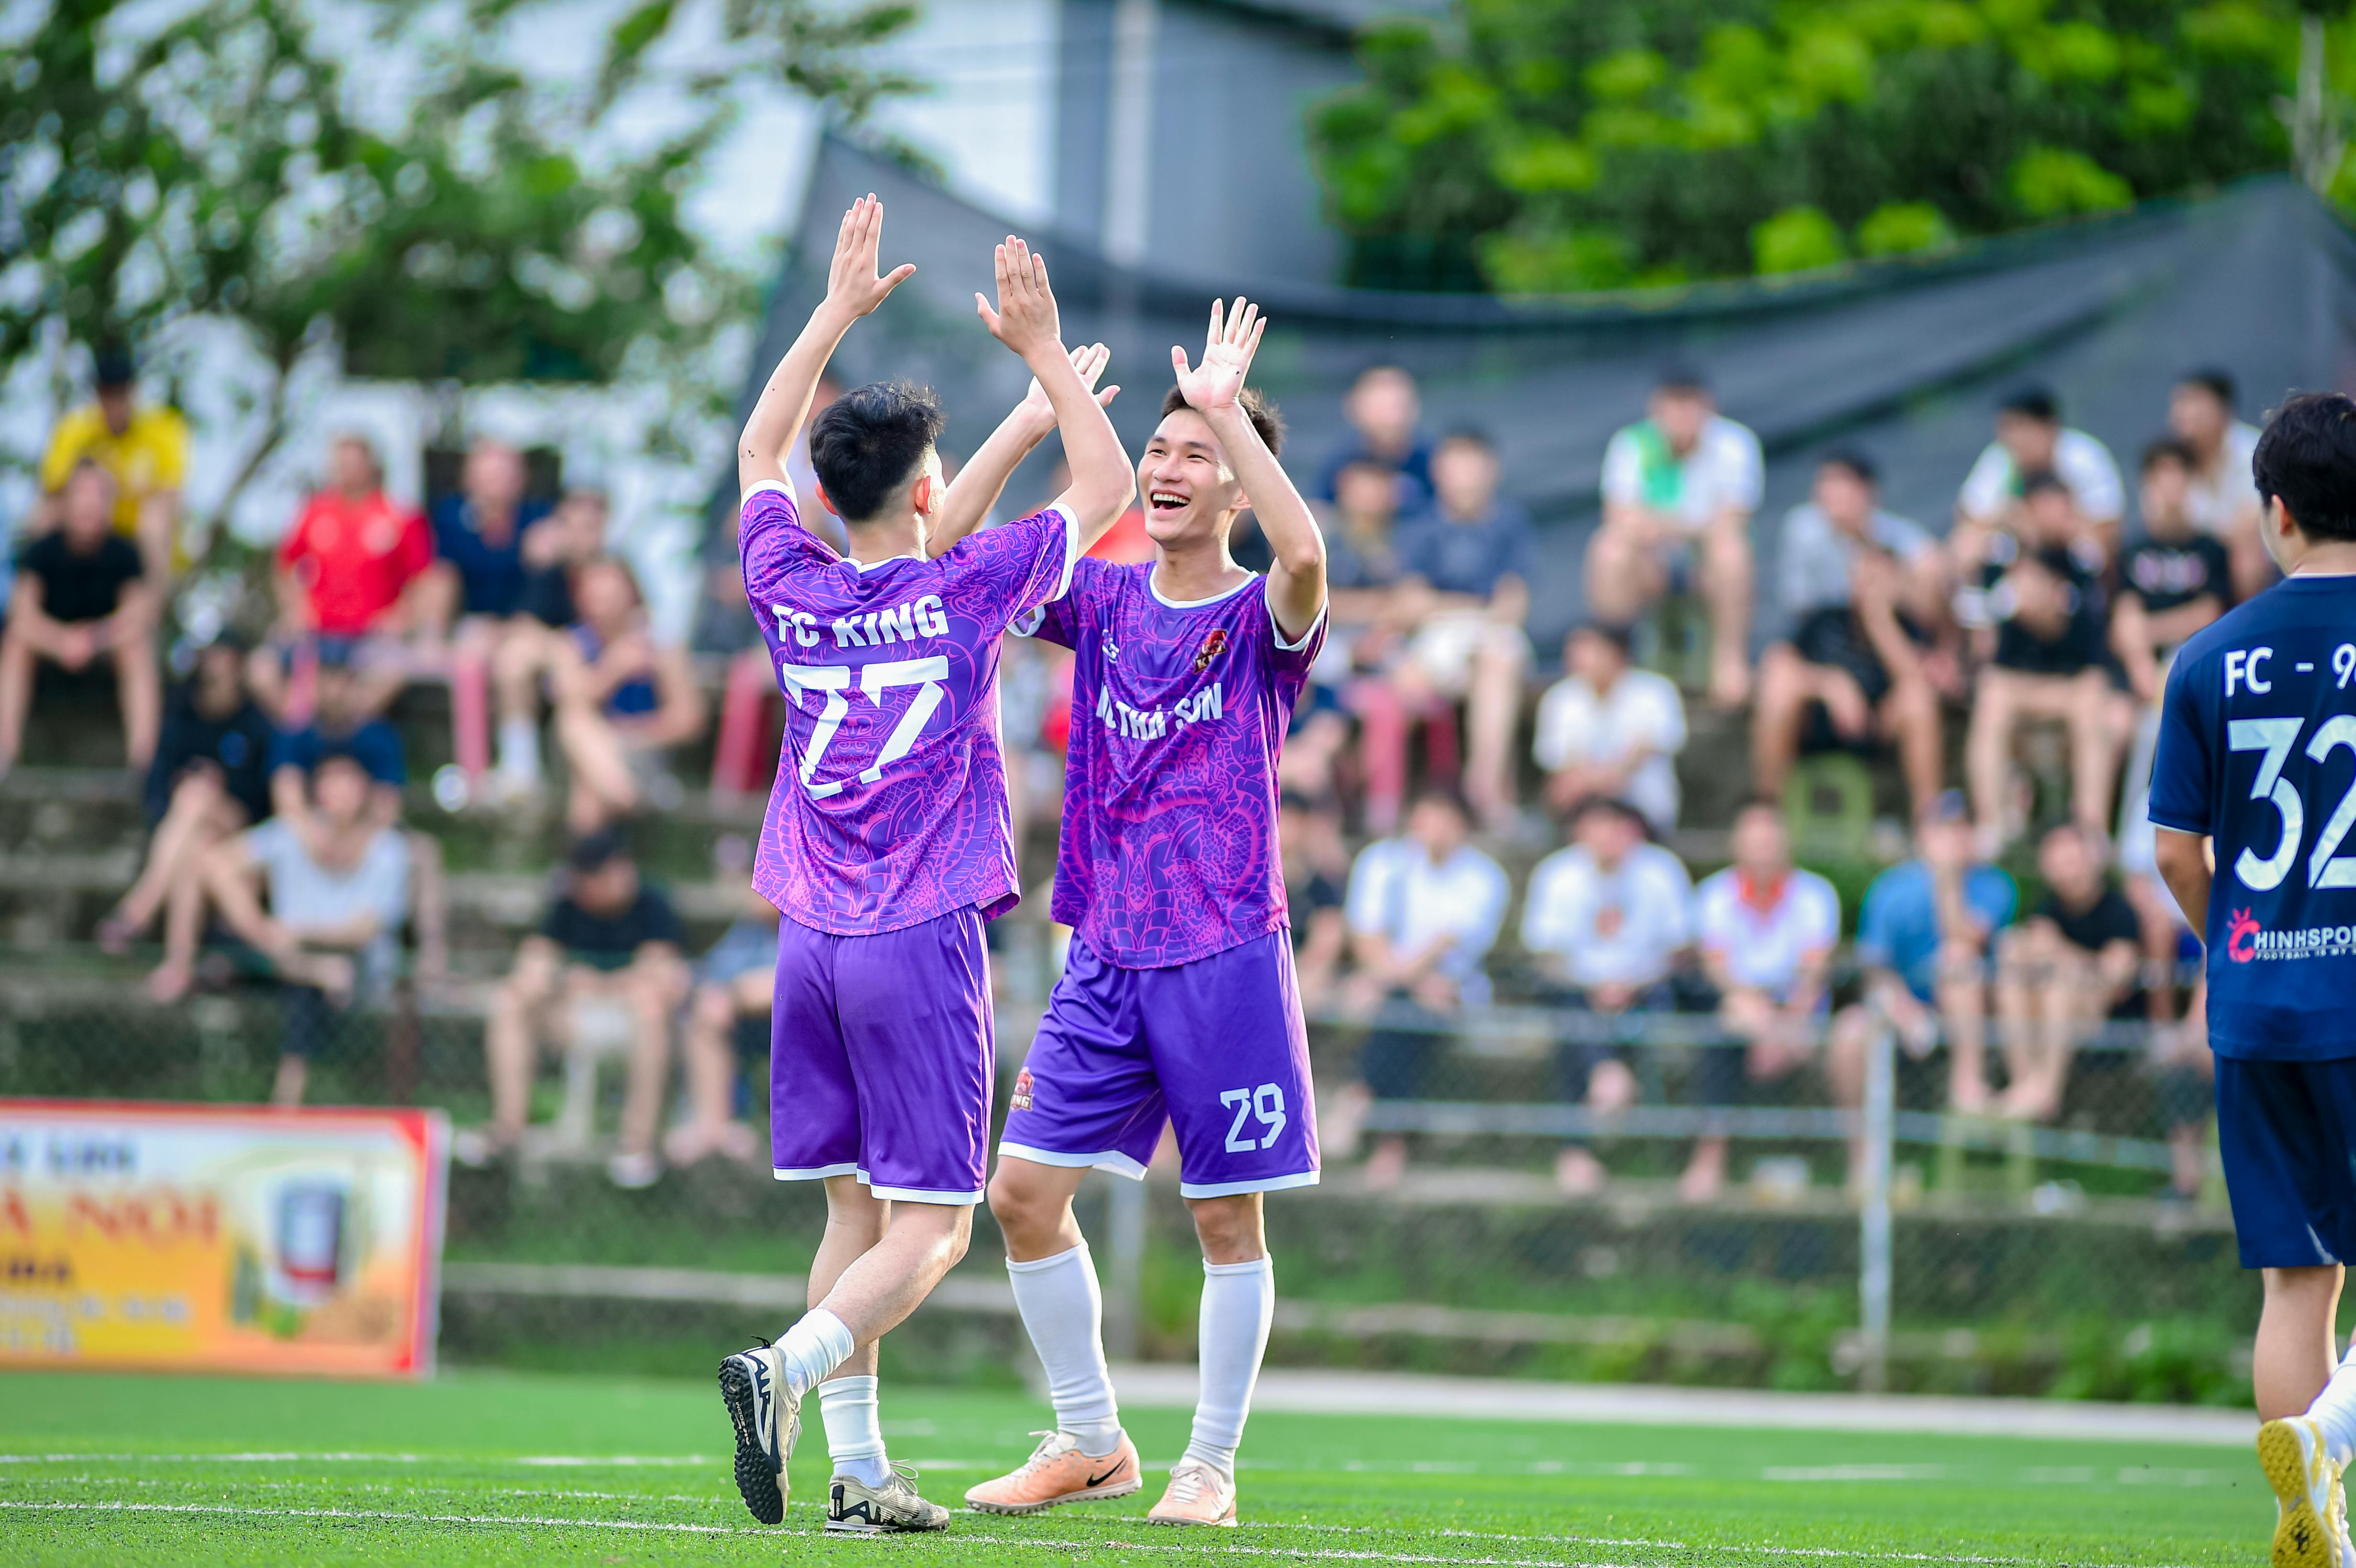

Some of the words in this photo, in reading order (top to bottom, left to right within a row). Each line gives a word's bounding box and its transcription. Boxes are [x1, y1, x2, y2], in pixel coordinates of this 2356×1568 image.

[772, 604, 820, 647] FC
[832, 595, 949, 648] KING
[2224, 647, 2273, 698] FC
[2332, 643, 2356, 689] 9
[2227, 714, 2356, 892] 32
[2228, 920, 2356, 964] CHINHSPO
[2255, 949, 2311, 961] FOOTBALL
[1220, 1082, 1287, 1154] 29
